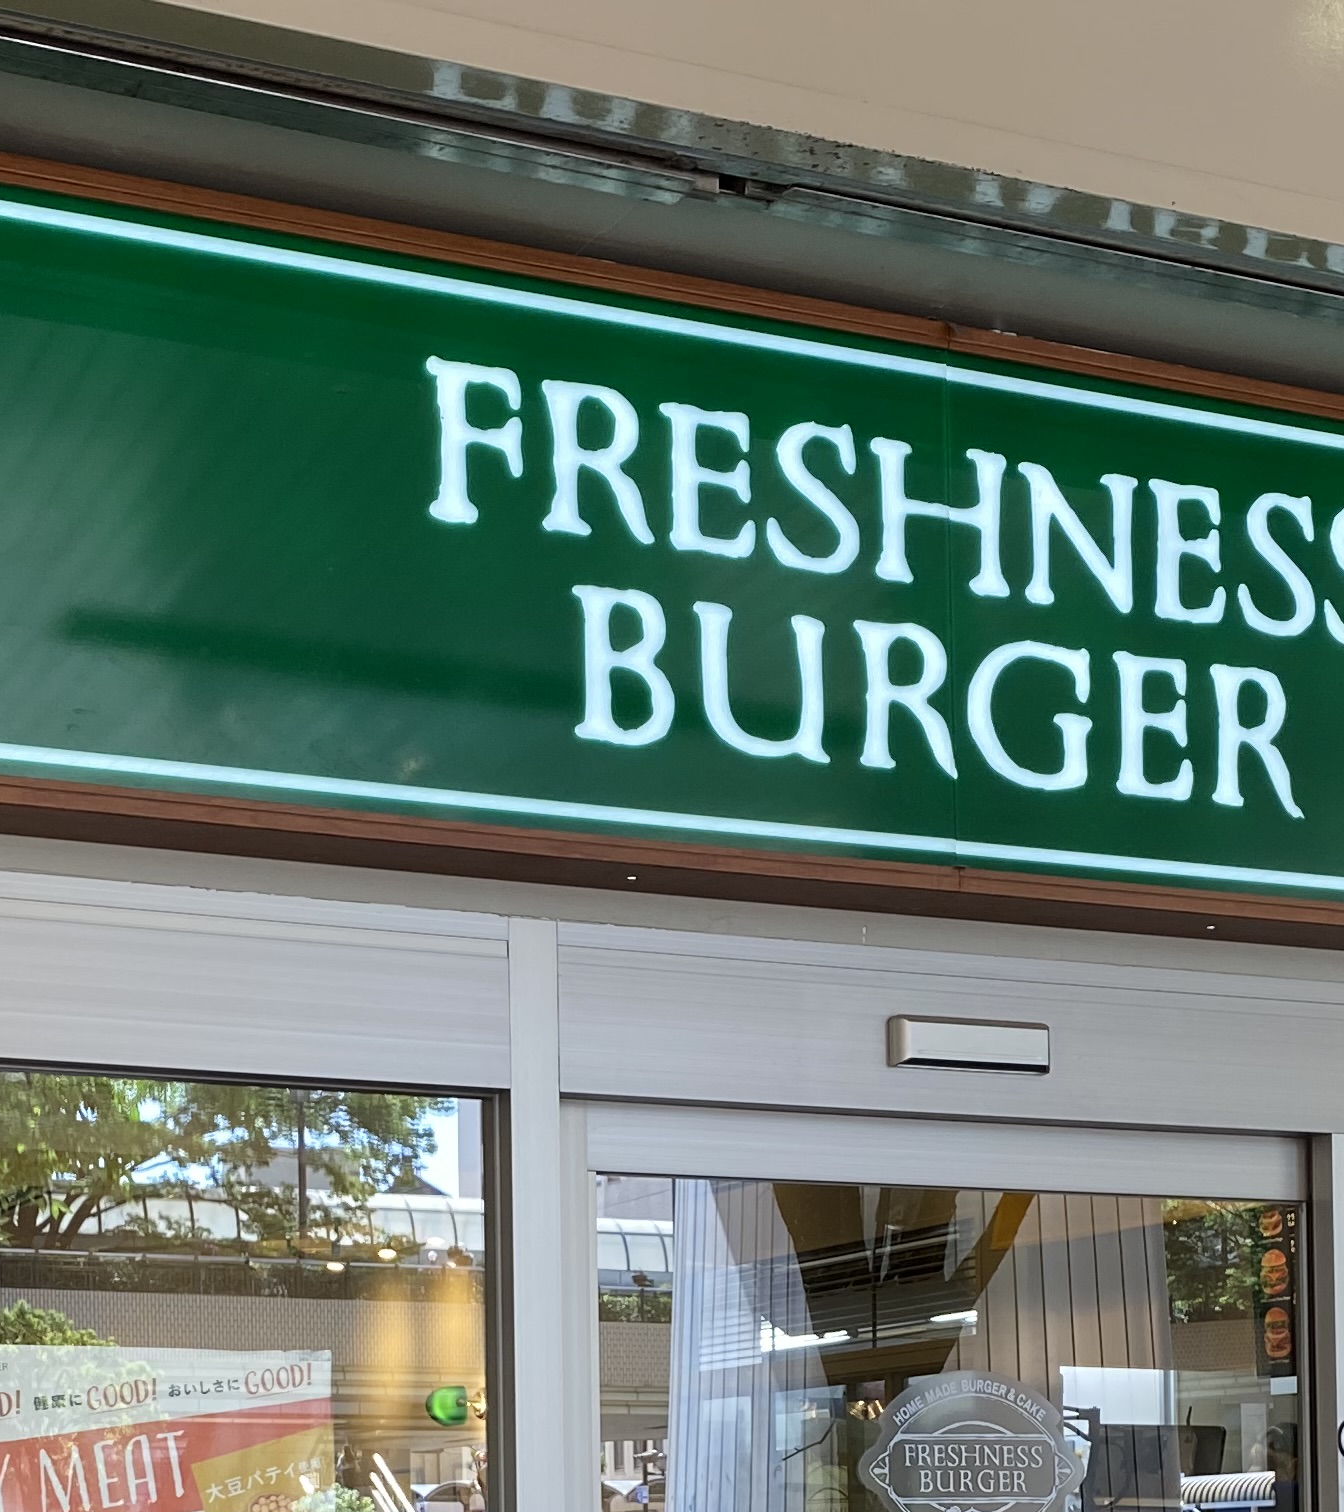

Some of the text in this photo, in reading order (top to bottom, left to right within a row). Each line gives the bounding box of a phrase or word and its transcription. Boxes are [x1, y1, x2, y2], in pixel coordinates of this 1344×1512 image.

[571, 584, 1305, 819] BURGER
[892, 1379, 1047, 1426] HOME MADE BURGER & CAKE
[904, 1443, 1043, 1468] FRESHNESS
[919, 1469, 1028, 1493] BURGER
